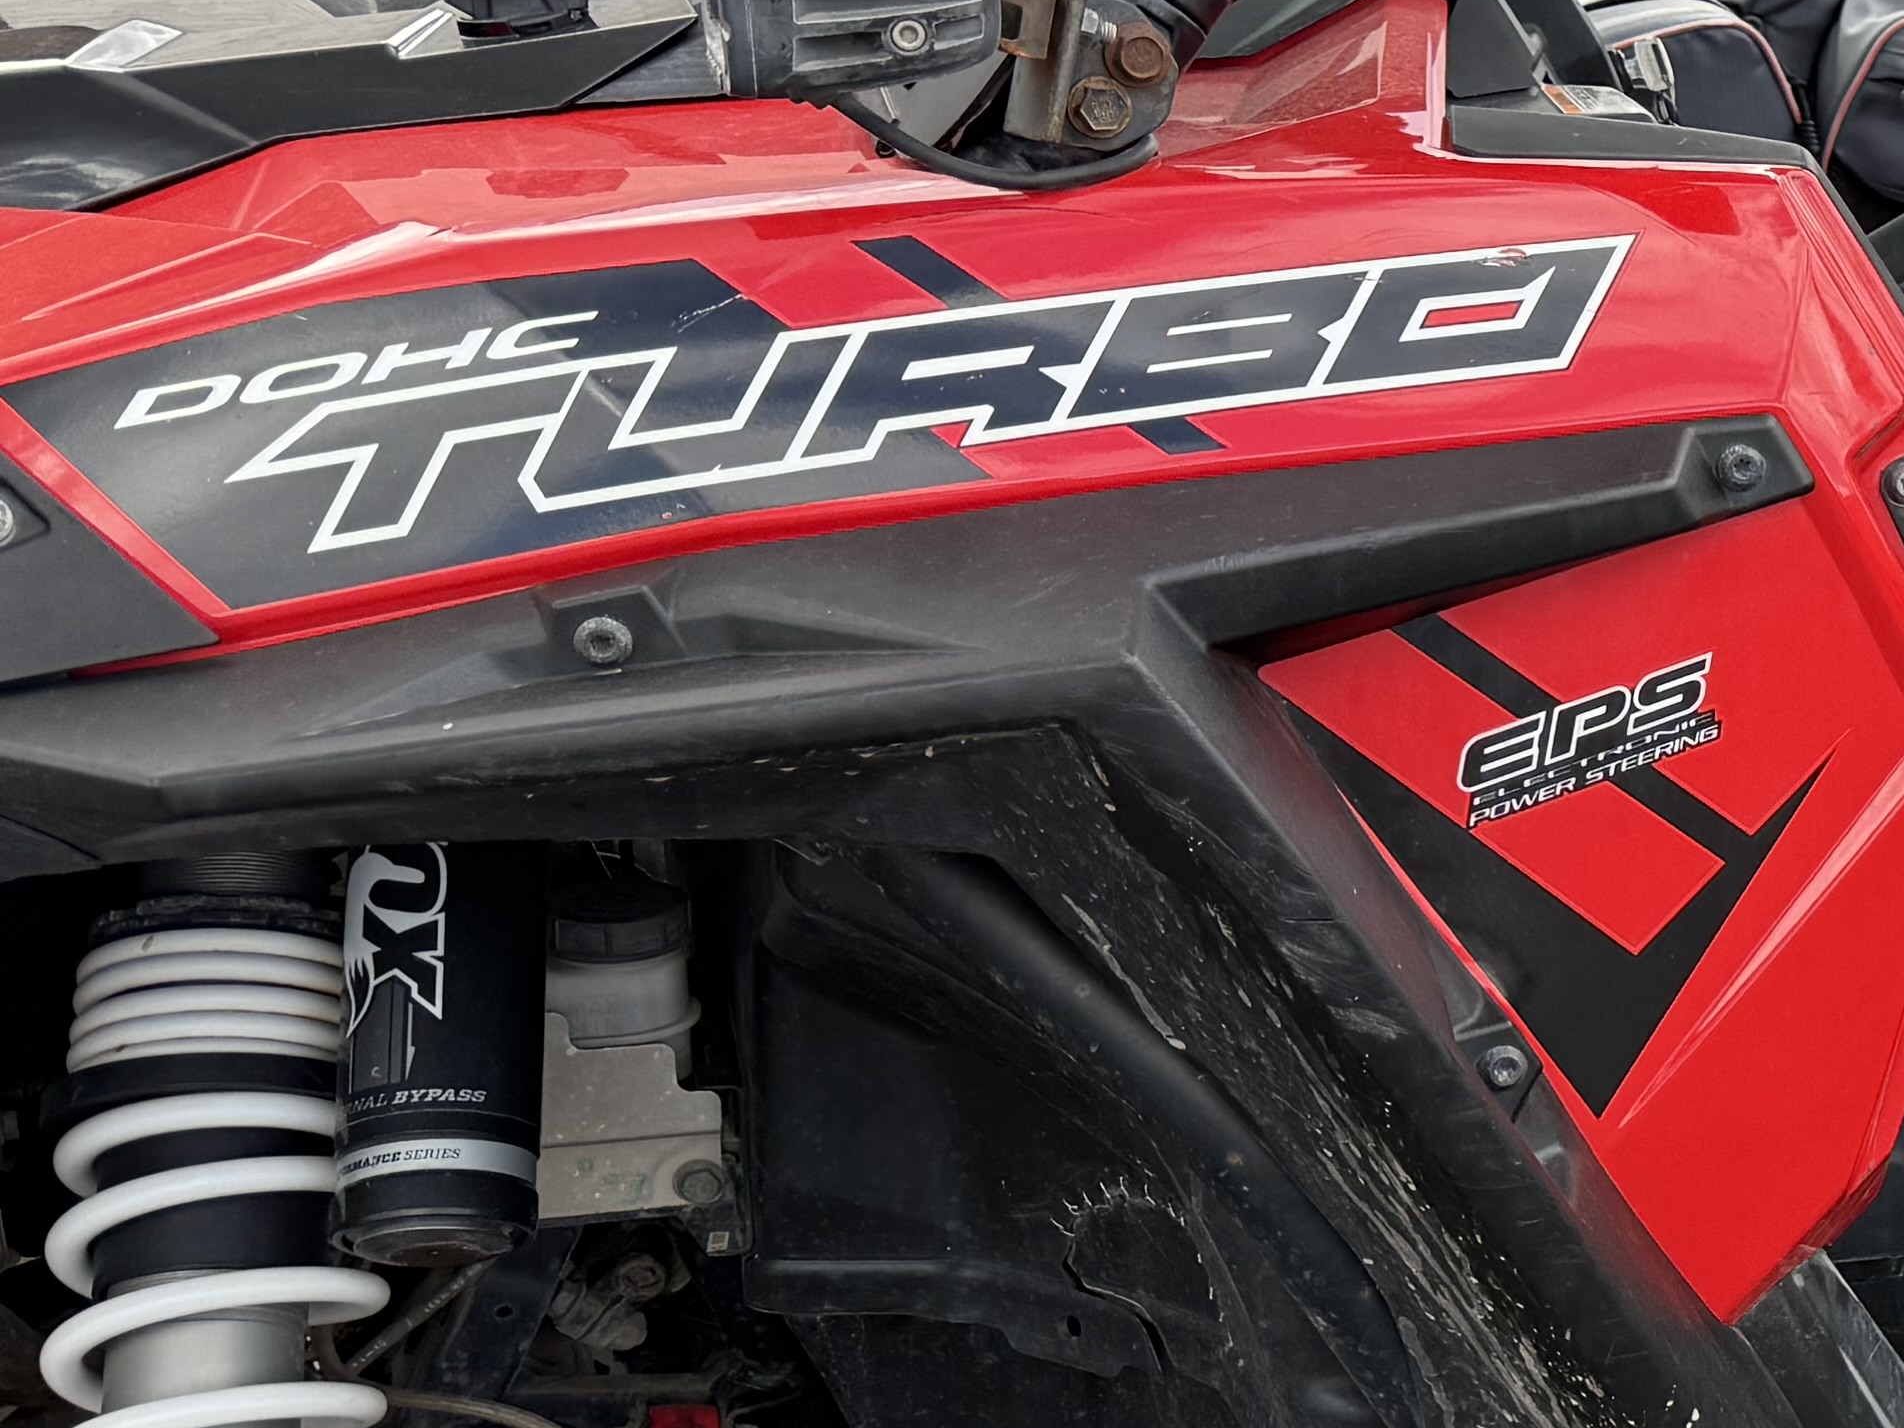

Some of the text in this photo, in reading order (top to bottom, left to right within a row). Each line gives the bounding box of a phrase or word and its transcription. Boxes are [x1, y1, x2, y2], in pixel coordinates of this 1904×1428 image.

[115, 311, 598, 430] DOHC
[225, 234, 1638, 553] TURBO
[1457, 652, 1713, 793] EPS
[1472, 713, 1716, 808] ELECTRONIC
[1469, 725, 1720, 828] POWER STEERING
[391, 1087, 487, 1105] BYPASS
[403, 1148, 461, 1162] SERIES
